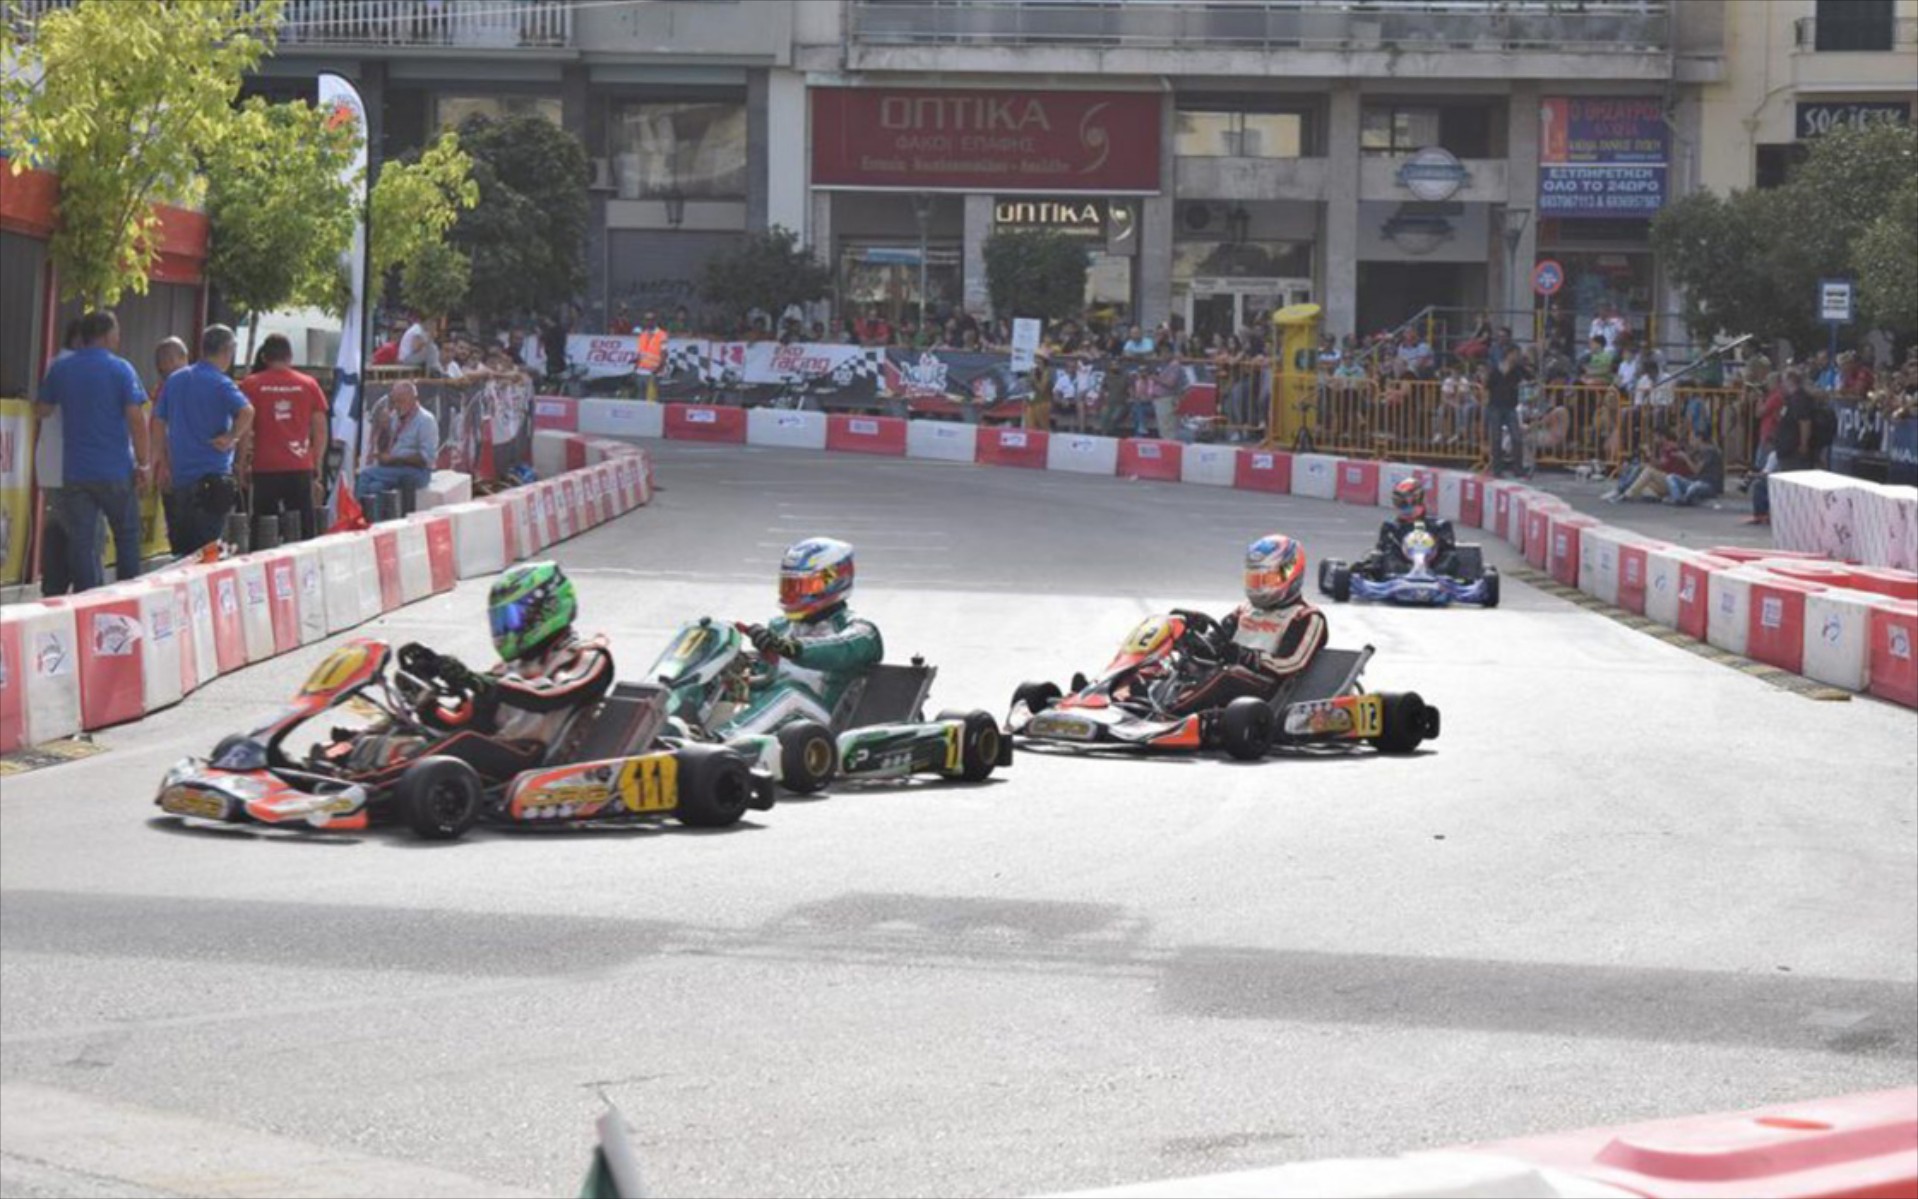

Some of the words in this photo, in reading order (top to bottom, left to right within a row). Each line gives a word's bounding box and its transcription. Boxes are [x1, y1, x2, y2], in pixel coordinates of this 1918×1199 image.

[1582, 180, 1603, 192] ΤΟ
[586, 349, 638, 364] racin
[1360, 702, 1378, 730] 12
[634, 761, 664, 807] 11
